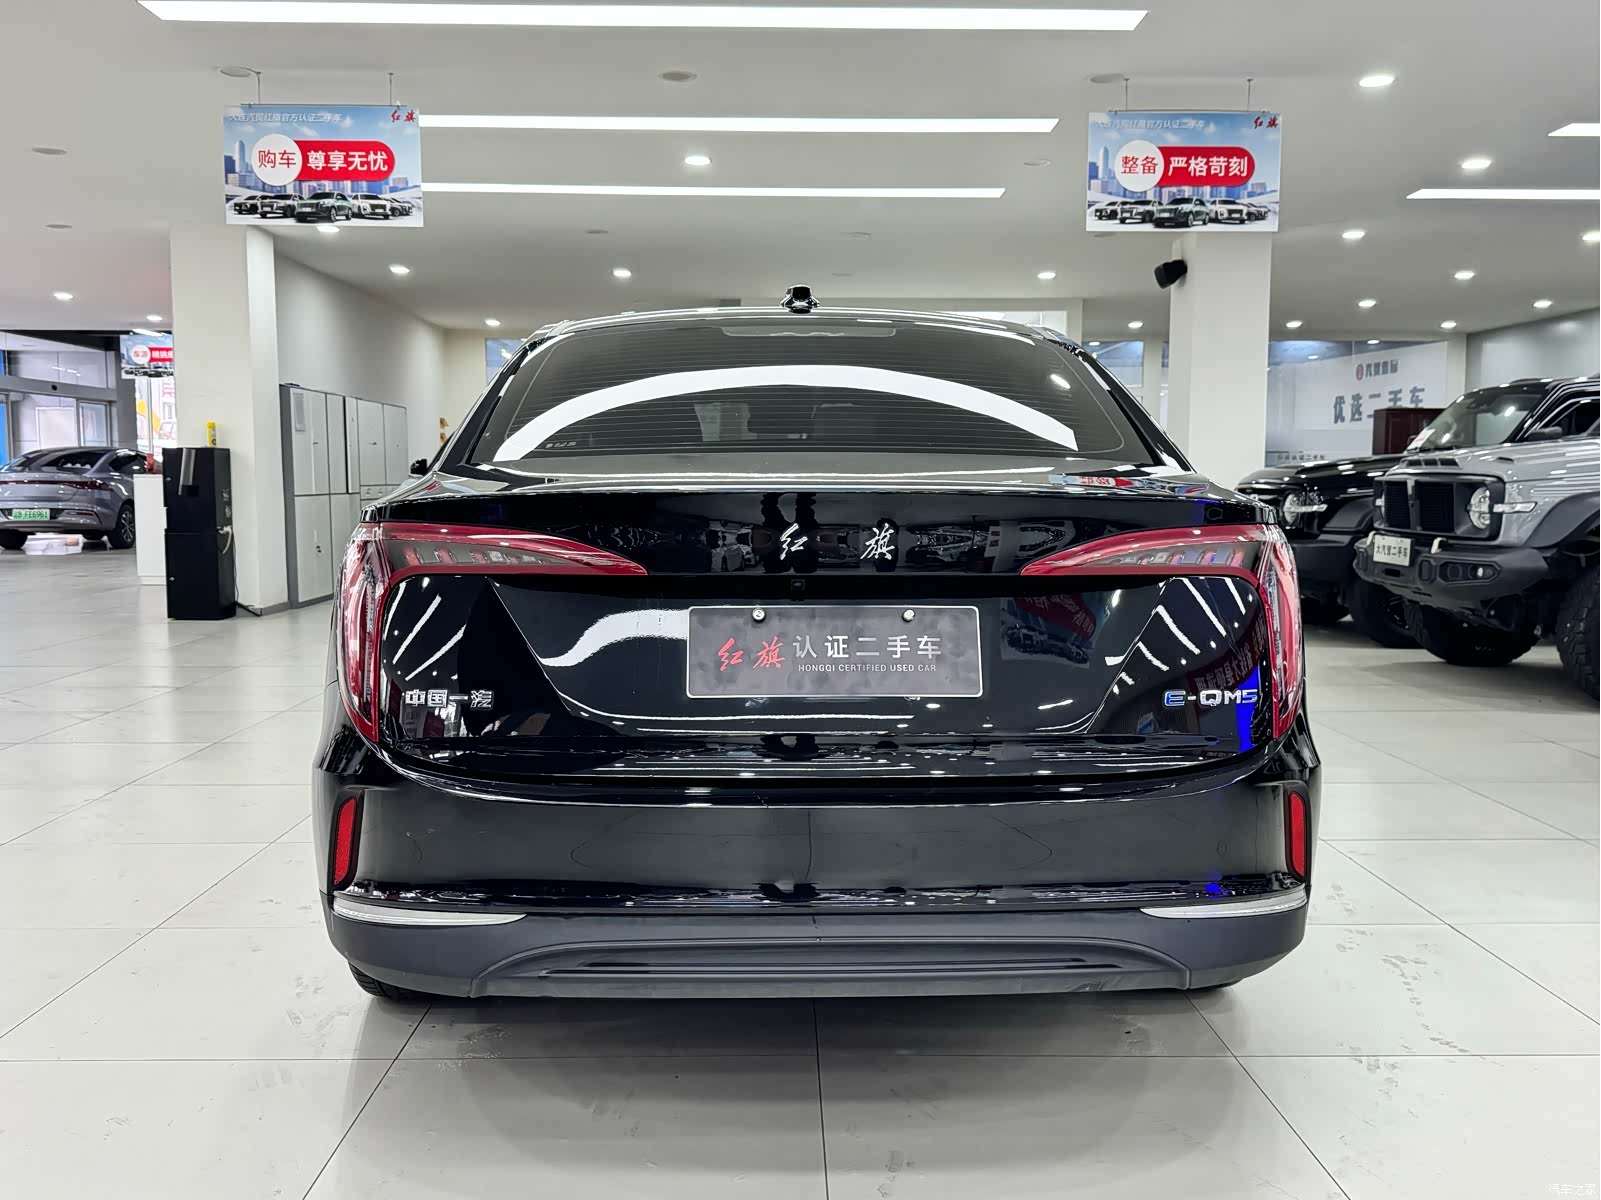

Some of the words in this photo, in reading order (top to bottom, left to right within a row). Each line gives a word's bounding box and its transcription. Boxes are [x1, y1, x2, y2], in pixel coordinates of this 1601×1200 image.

[391, 109, 416, 123] 红旗
[1253, 115, 1279, 129] 红旗
[258, 149, 296, 169] 购车
[306, 150, 389, 171] 尊享无忧
[1121, 155, 1158, 175] 整备
[1168, 156, 1248, 177] 严格苛刻
[1333, 385, 1425, 424] 优选二手车
[779, 522, 896, 560] 红旗
[717, 636, 786, 672] 红旗
[792, 634, 942, 660] 认证二手车
[798, 664, 836, 673] HONGQI
[838, 664, 887, 673] CERTIFIED
[889, 664, 915, 673] USED
[917, 664, 937, 673] CAR
[404, 688, 494, 709] 中国一汽
[1164, 688, 1259, 707] E-QM5
